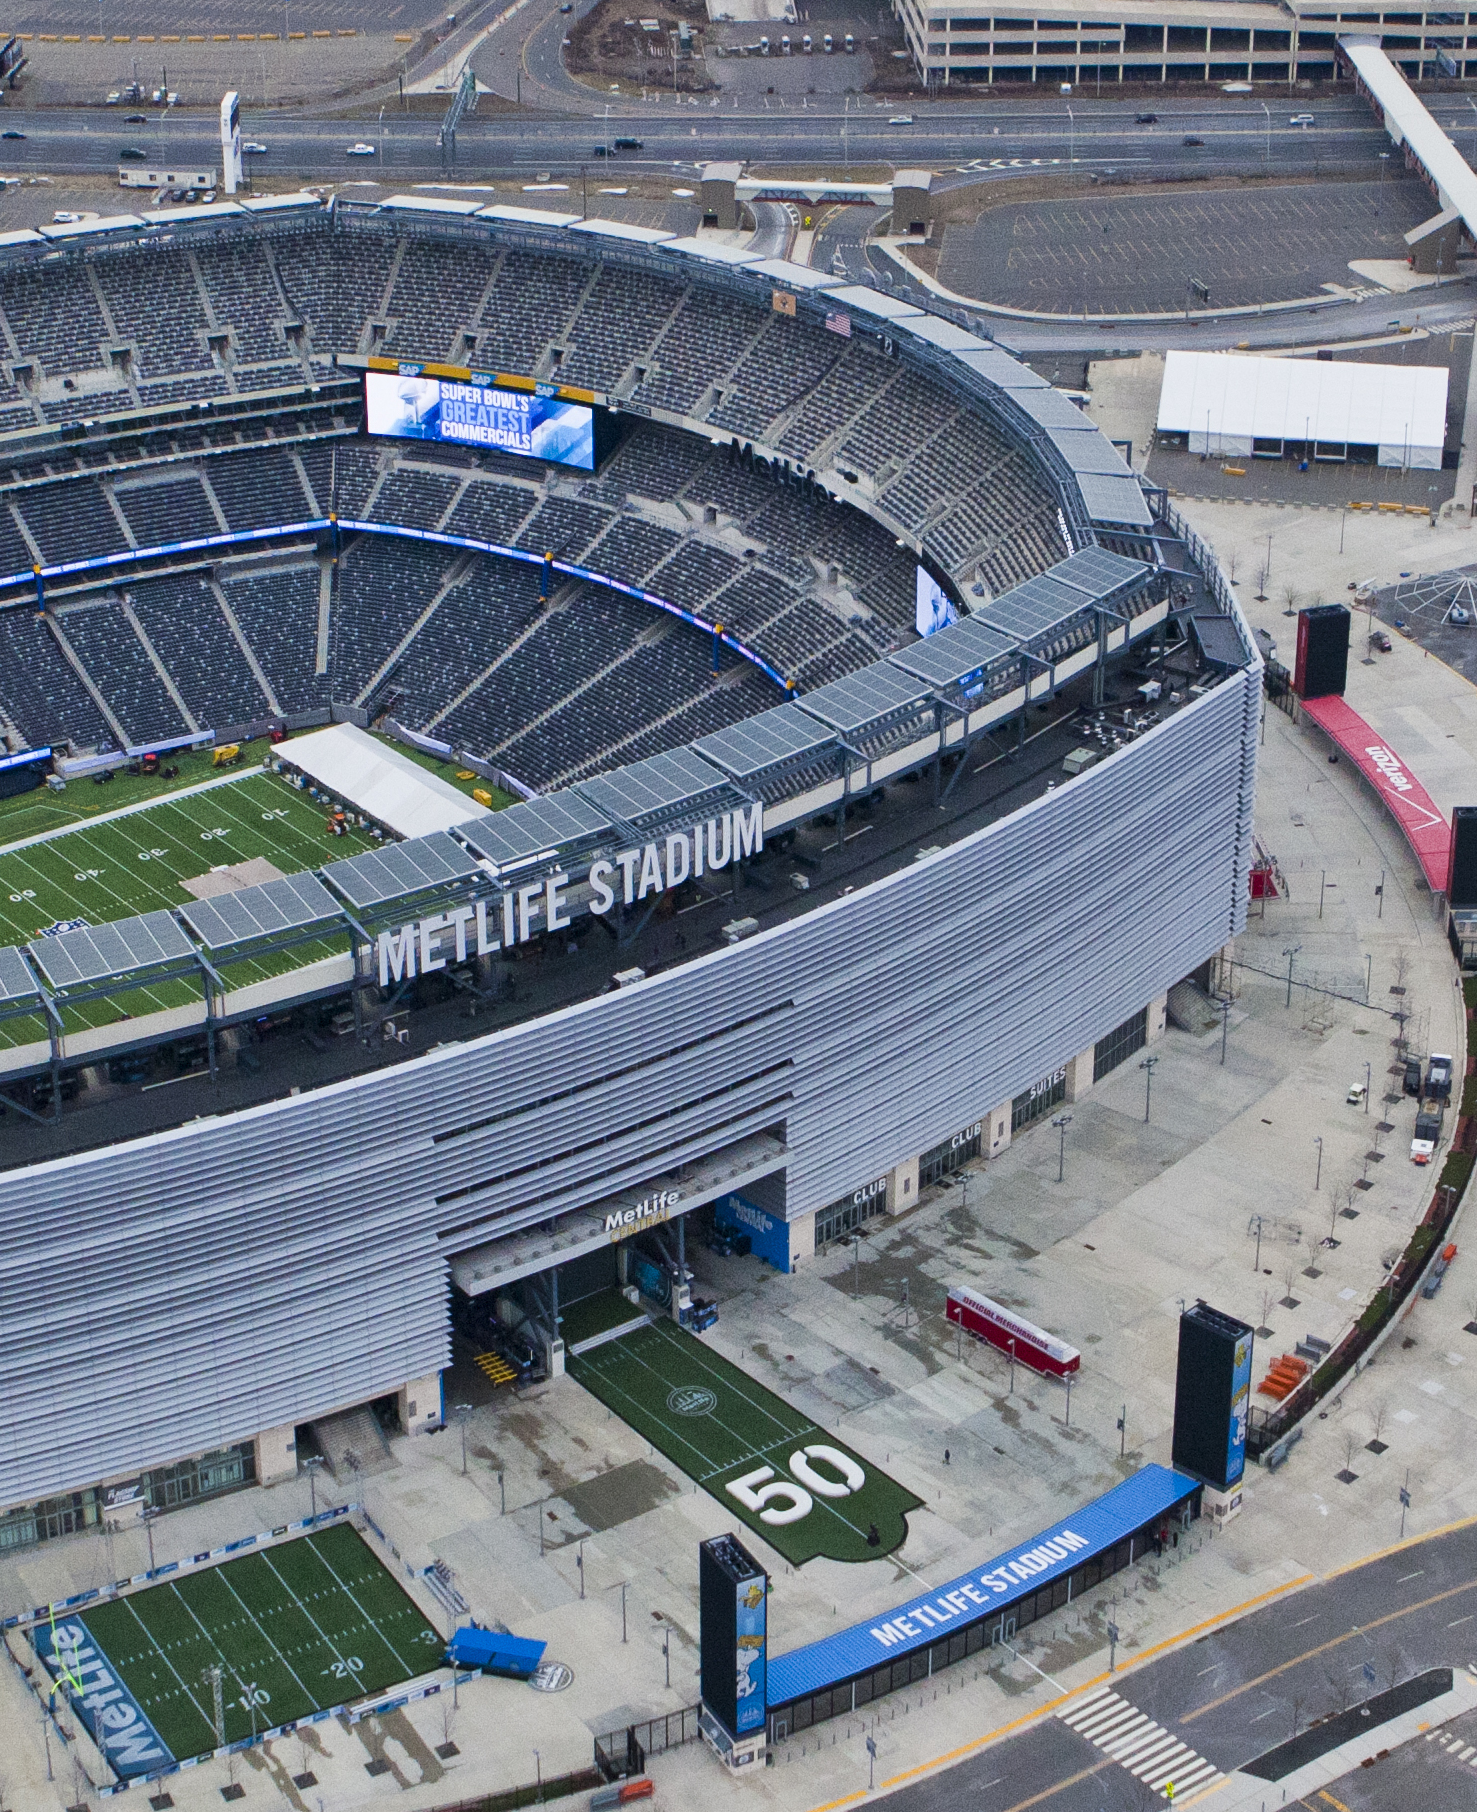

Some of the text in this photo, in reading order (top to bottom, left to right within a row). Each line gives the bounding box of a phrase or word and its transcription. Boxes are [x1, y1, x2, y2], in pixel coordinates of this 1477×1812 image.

[398, 364, 420, 377] SAP
[471, 373, 492, 386] SAP
[441, 383, 529, 412] SUPER BOWL'S
[535, 383, 555, 397] SAP
[441, 400, 530, 433] GREATEST
[441, 423, 531, 450] COMMERCIALS
[1365, 746, 1413, 791] verizon
[262, 807, 285, 821] 10
[200, 827, 226, 841] 20
[138, 847, 165, 861] 30
[74, 868, 100, 882] 40
[9, 889, 37, 902] 50
[378, 801, 763, 987] METLIFE STADIUM
[1030, 1066, 1067, 1100] SUITES
[951, 1121, 982, 1149] CLUB
[853, 1177, 887, 1204] CLUB
[605, 1190, 680, 1232] MetLife
[610, 1208, 671, 1243] CENTRAL
[963, 1296, 1049, 1350] OFFICIAL MERCHANDISE
[725, 1444, 866, 1526] 50
[870, 1529, 1090, 1647] METLIFE STADIUM
[330, 1656, 365, 1679] 20
[45, 1624, 165, 1765] MetLife
[238, 1689, 271, 1711] 10
